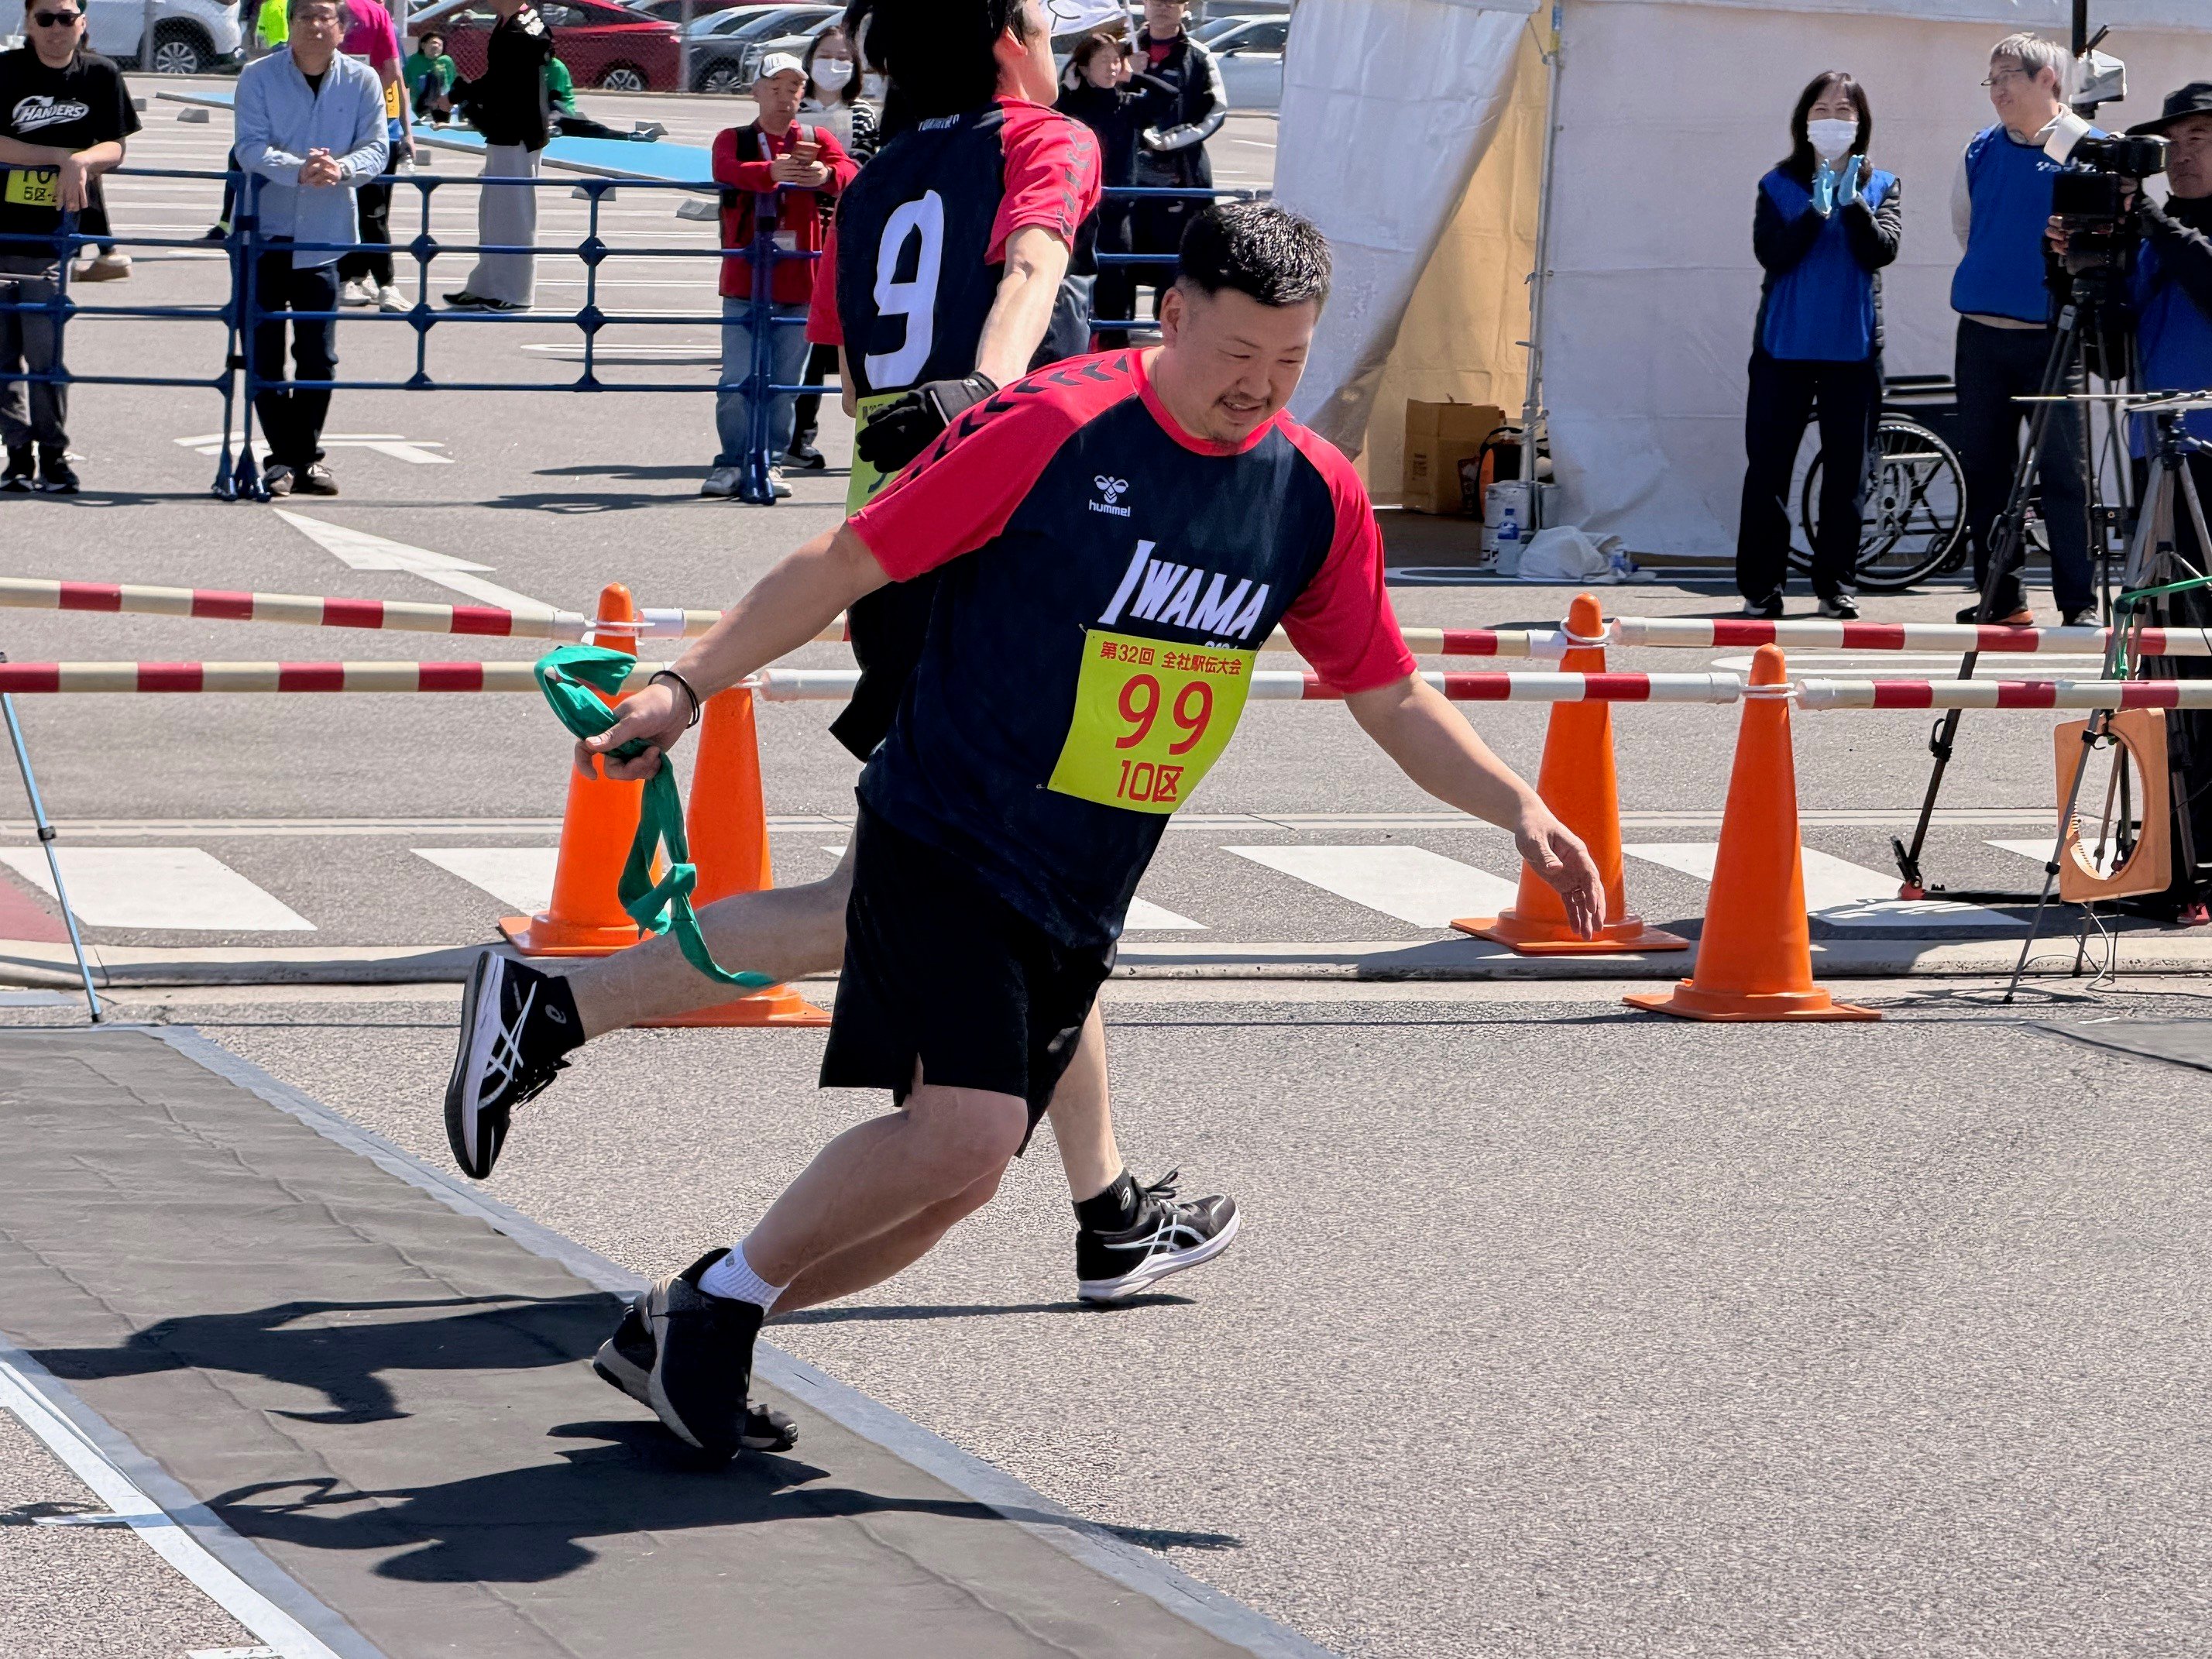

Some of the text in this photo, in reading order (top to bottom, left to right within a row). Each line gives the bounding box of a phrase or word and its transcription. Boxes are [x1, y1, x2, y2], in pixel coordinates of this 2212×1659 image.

[864, 189, 945, 390] 9
[1088, 499, 1131, 517] hummel
[1097, 539, 1270, 641] IWAMA
[1100, 641, 1242, 676] 第32回 全社駅伝大会
[1115, 673, 1214, 756] 99
[1116, 759, 1185, 803] 10区
